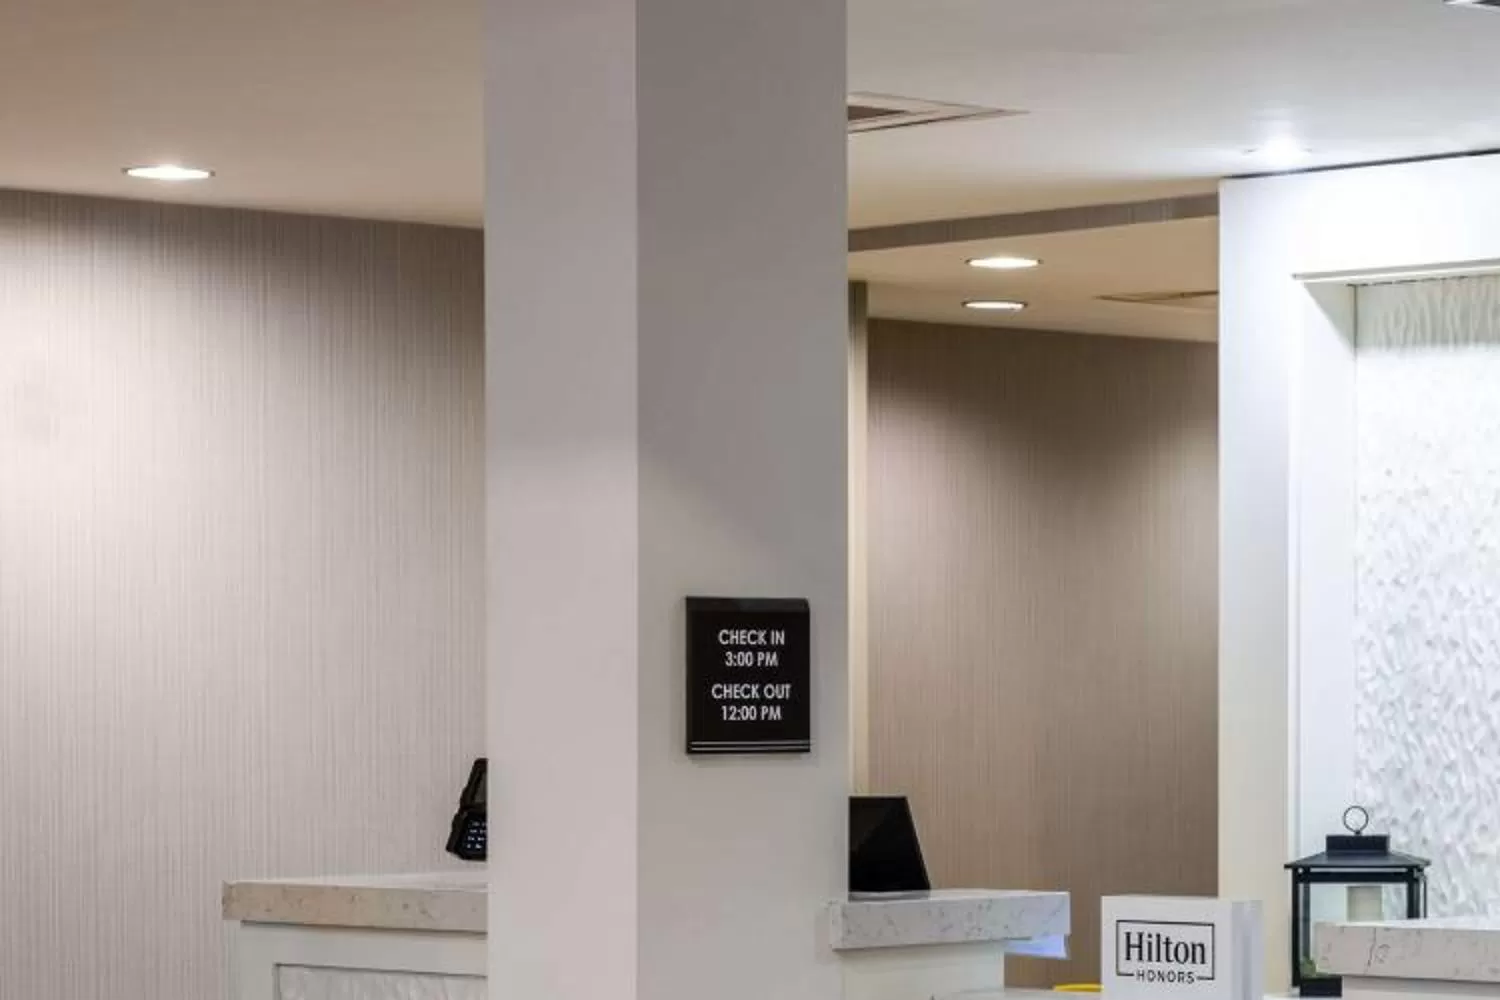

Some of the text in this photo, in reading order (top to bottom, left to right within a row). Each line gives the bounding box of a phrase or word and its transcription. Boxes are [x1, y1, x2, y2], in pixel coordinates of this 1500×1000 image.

[718, 629, 785, 645] CHECK IN
[725, 651, 778, 667] 3:00 PM
[711, 683, 791, 700] CHECK OUT
[722, 705, 782, 721] 12:00 PM
[1124, 931, 1207, 965] Hilton
[1136, 969, 1195, 985] HONORS
